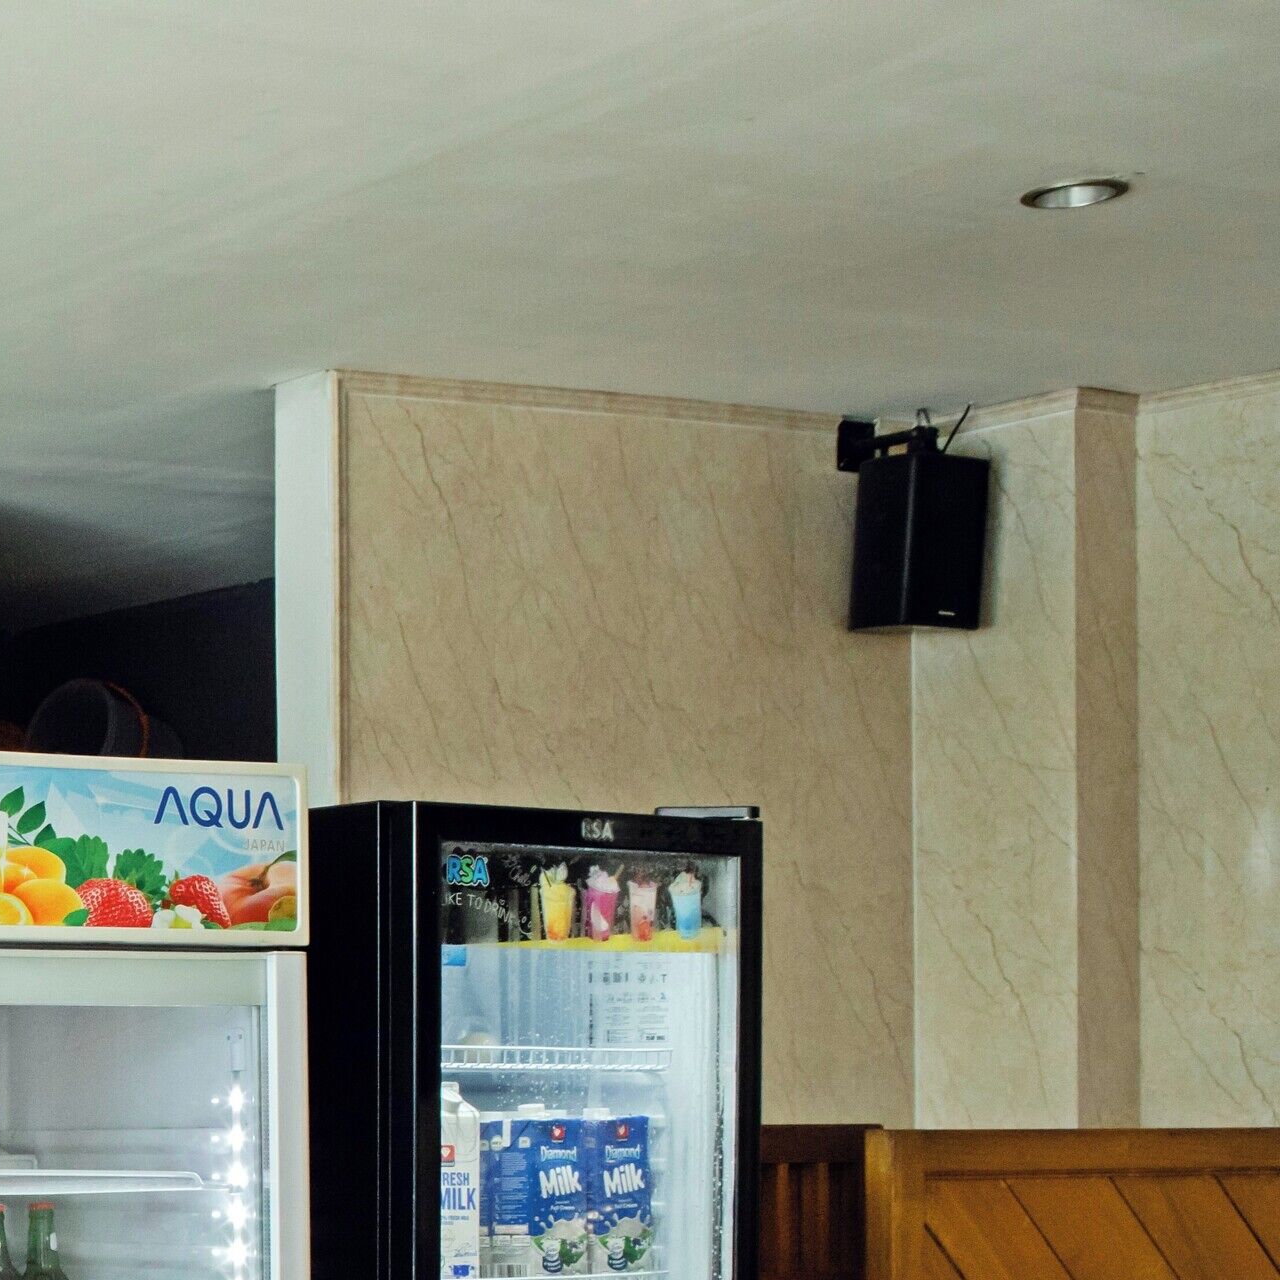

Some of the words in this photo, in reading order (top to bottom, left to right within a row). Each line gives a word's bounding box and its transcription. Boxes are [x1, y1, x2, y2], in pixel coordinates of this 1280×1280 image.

[154, 786, 284, 830] AQUA
[581, 818, 614, 842] RSA
[244, 839, 285, 851] JAPAN
[446, 854, 490, 887] RSA
[540, 1145, 577, 1161] Diamond
[605, 1144, 640, 1160] Diamond
[442, 1172, 470, 1186] RESH
[539, 1164, 582, 1199] Milk
[603, 1162, 645, 1198] Milk
